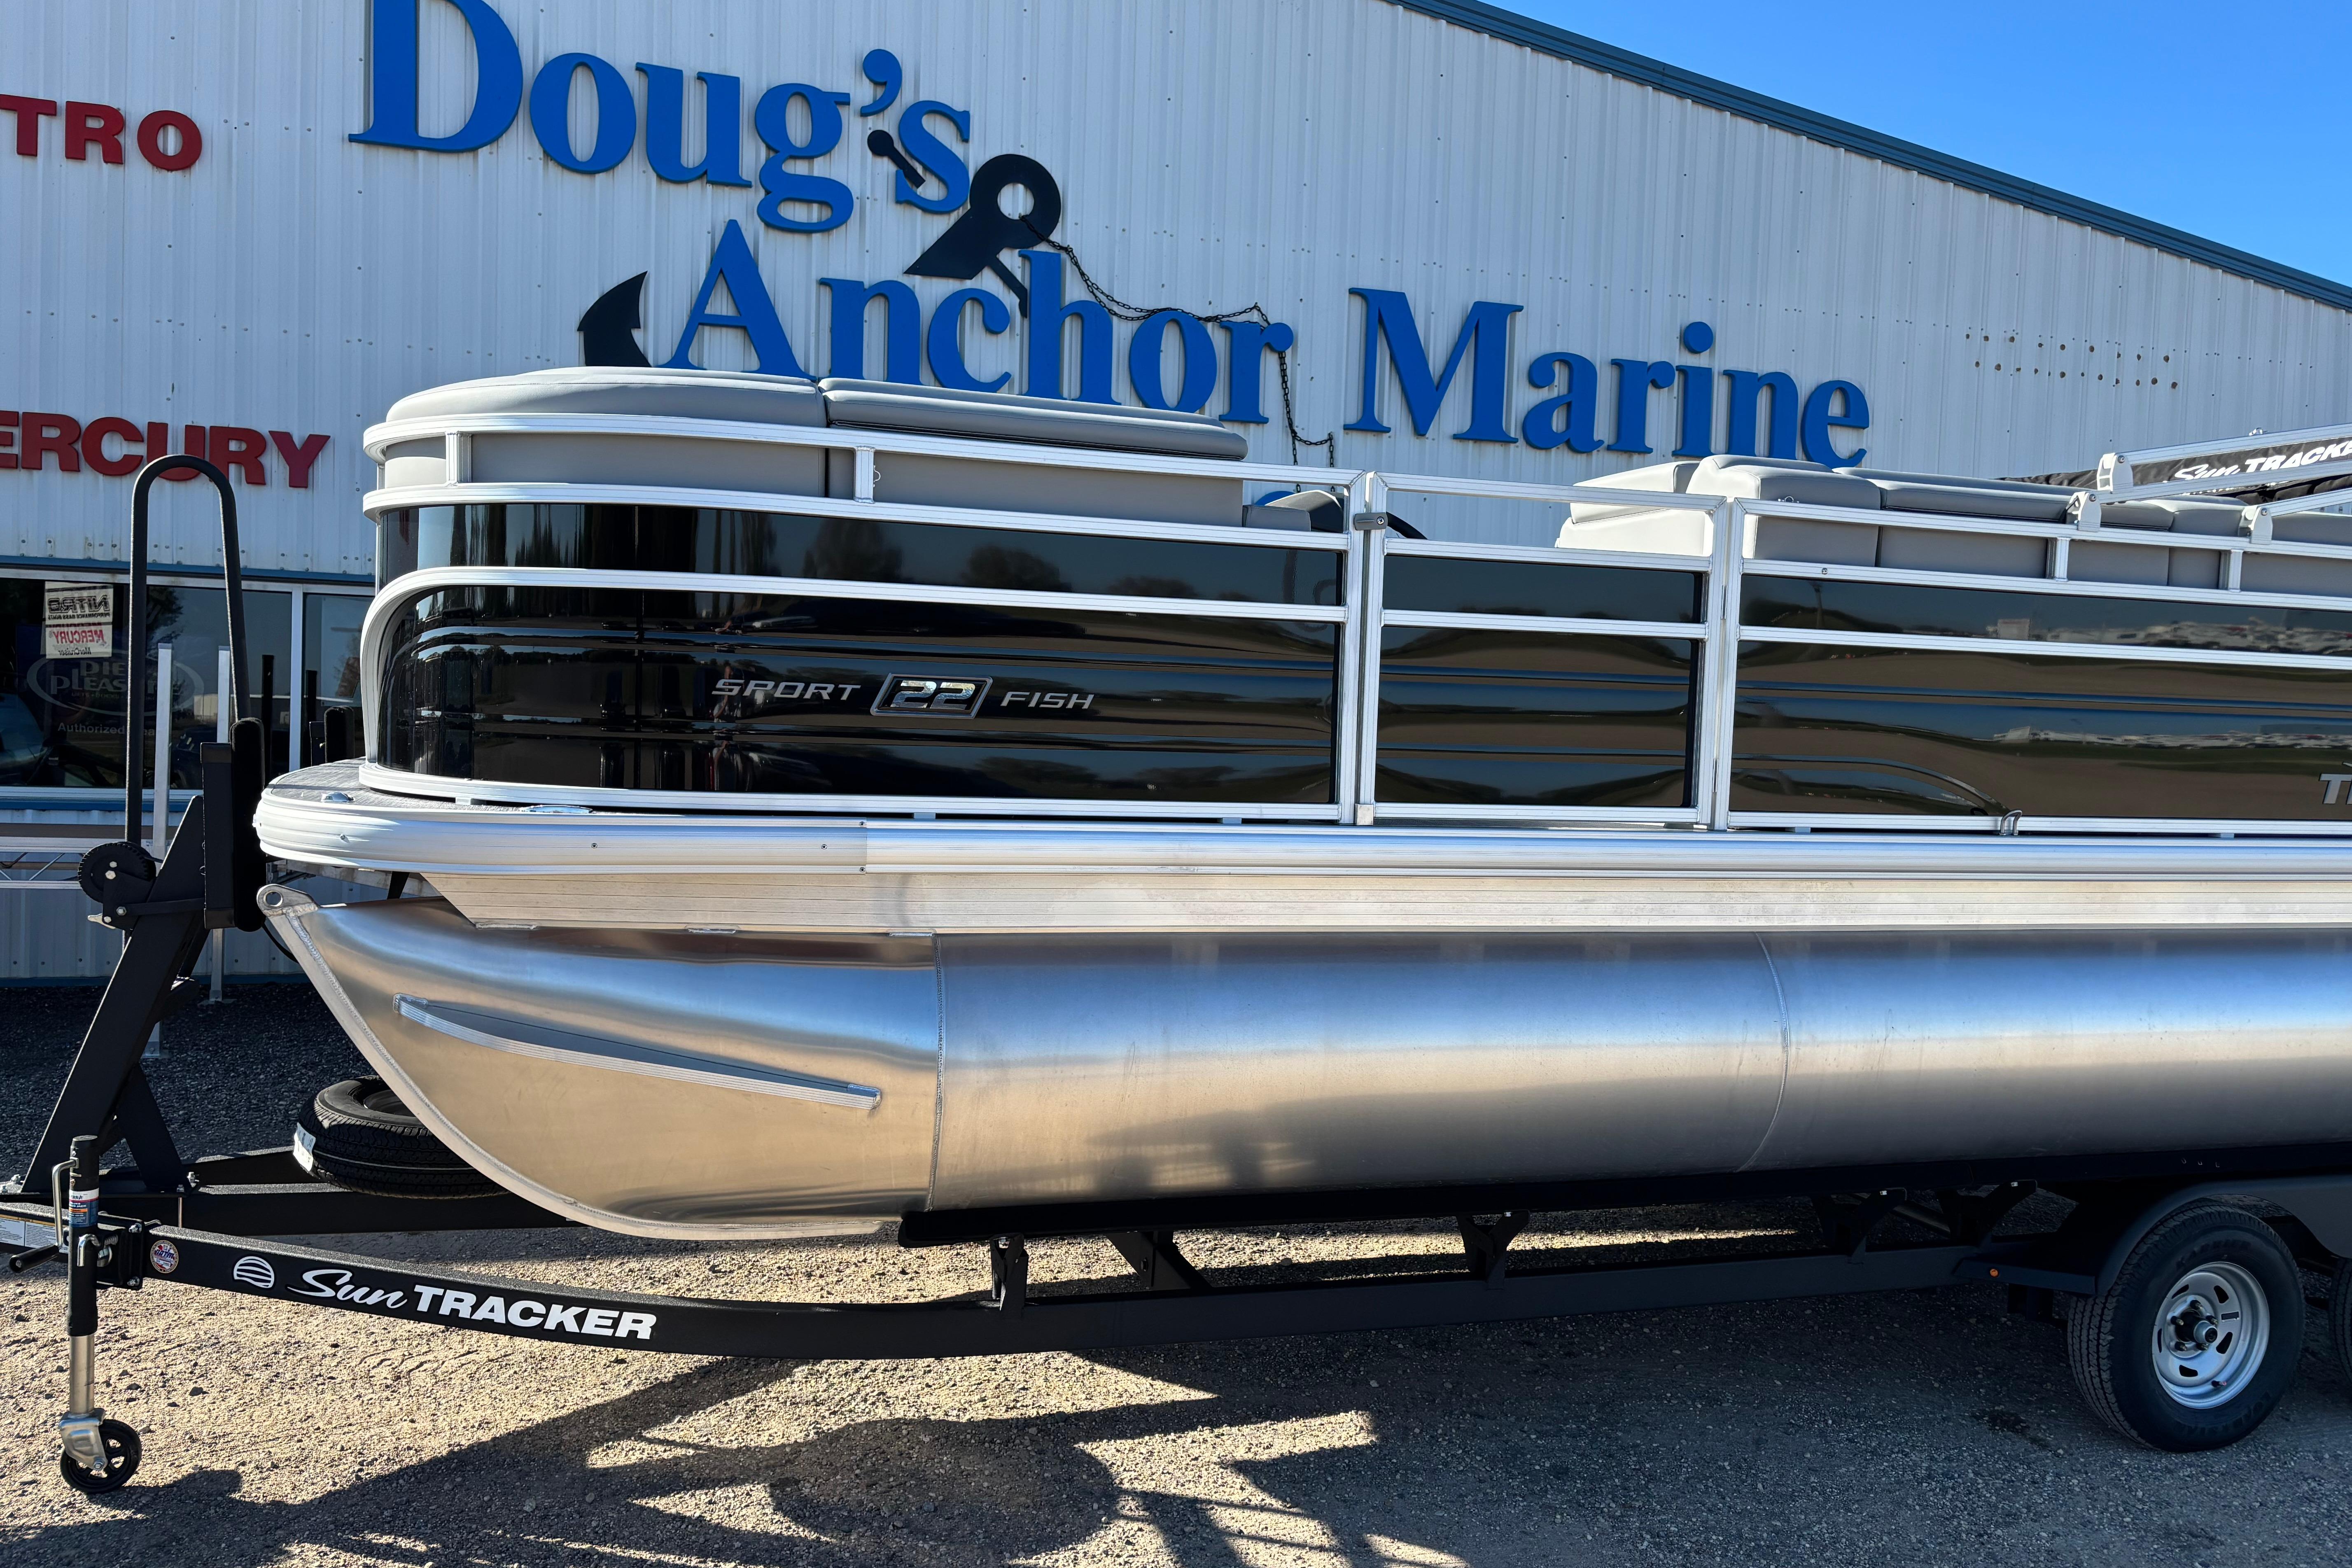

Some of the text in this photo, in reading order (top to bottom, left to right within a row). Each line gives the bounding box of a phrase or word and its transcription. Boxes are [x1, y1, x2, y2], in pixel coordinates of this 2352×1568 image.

[0, 93, 202, 171] TRO
[348, 0, 970, 233] Doug's
[658, 219, 1870, 468] Anchor Marine
[80, 660, 127, 676] PIE
[712, 679, 1094, 710] SPORT 22 FISH
[58, 722, 125, 735] Authorized
[2319, 773, 2352, 805] T
[287, 1269, 657, 1340] Sun TRACKER
